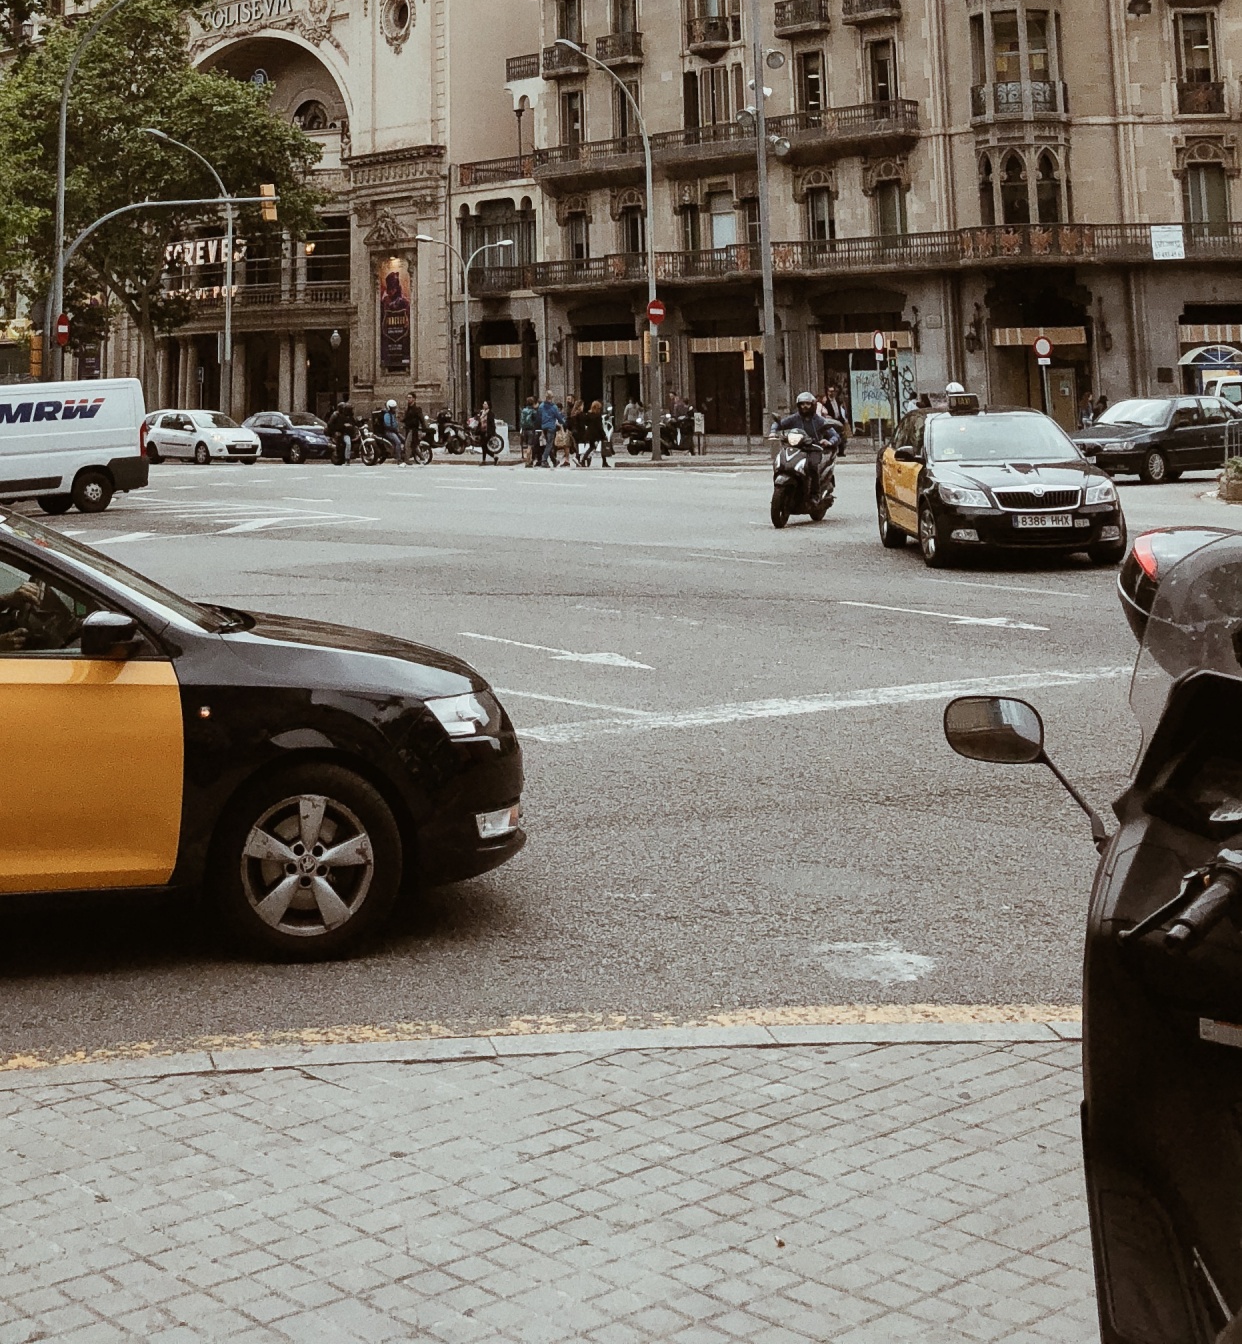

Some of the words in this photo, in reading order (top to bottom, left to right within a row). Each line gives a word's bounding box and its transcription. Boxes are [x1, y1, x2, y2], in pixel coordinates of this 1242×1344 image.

[0, 398, 106, 424] MRW
[1021, 517, 1047, 526] 8386
[1051, 516, 1070, 526] HHX
